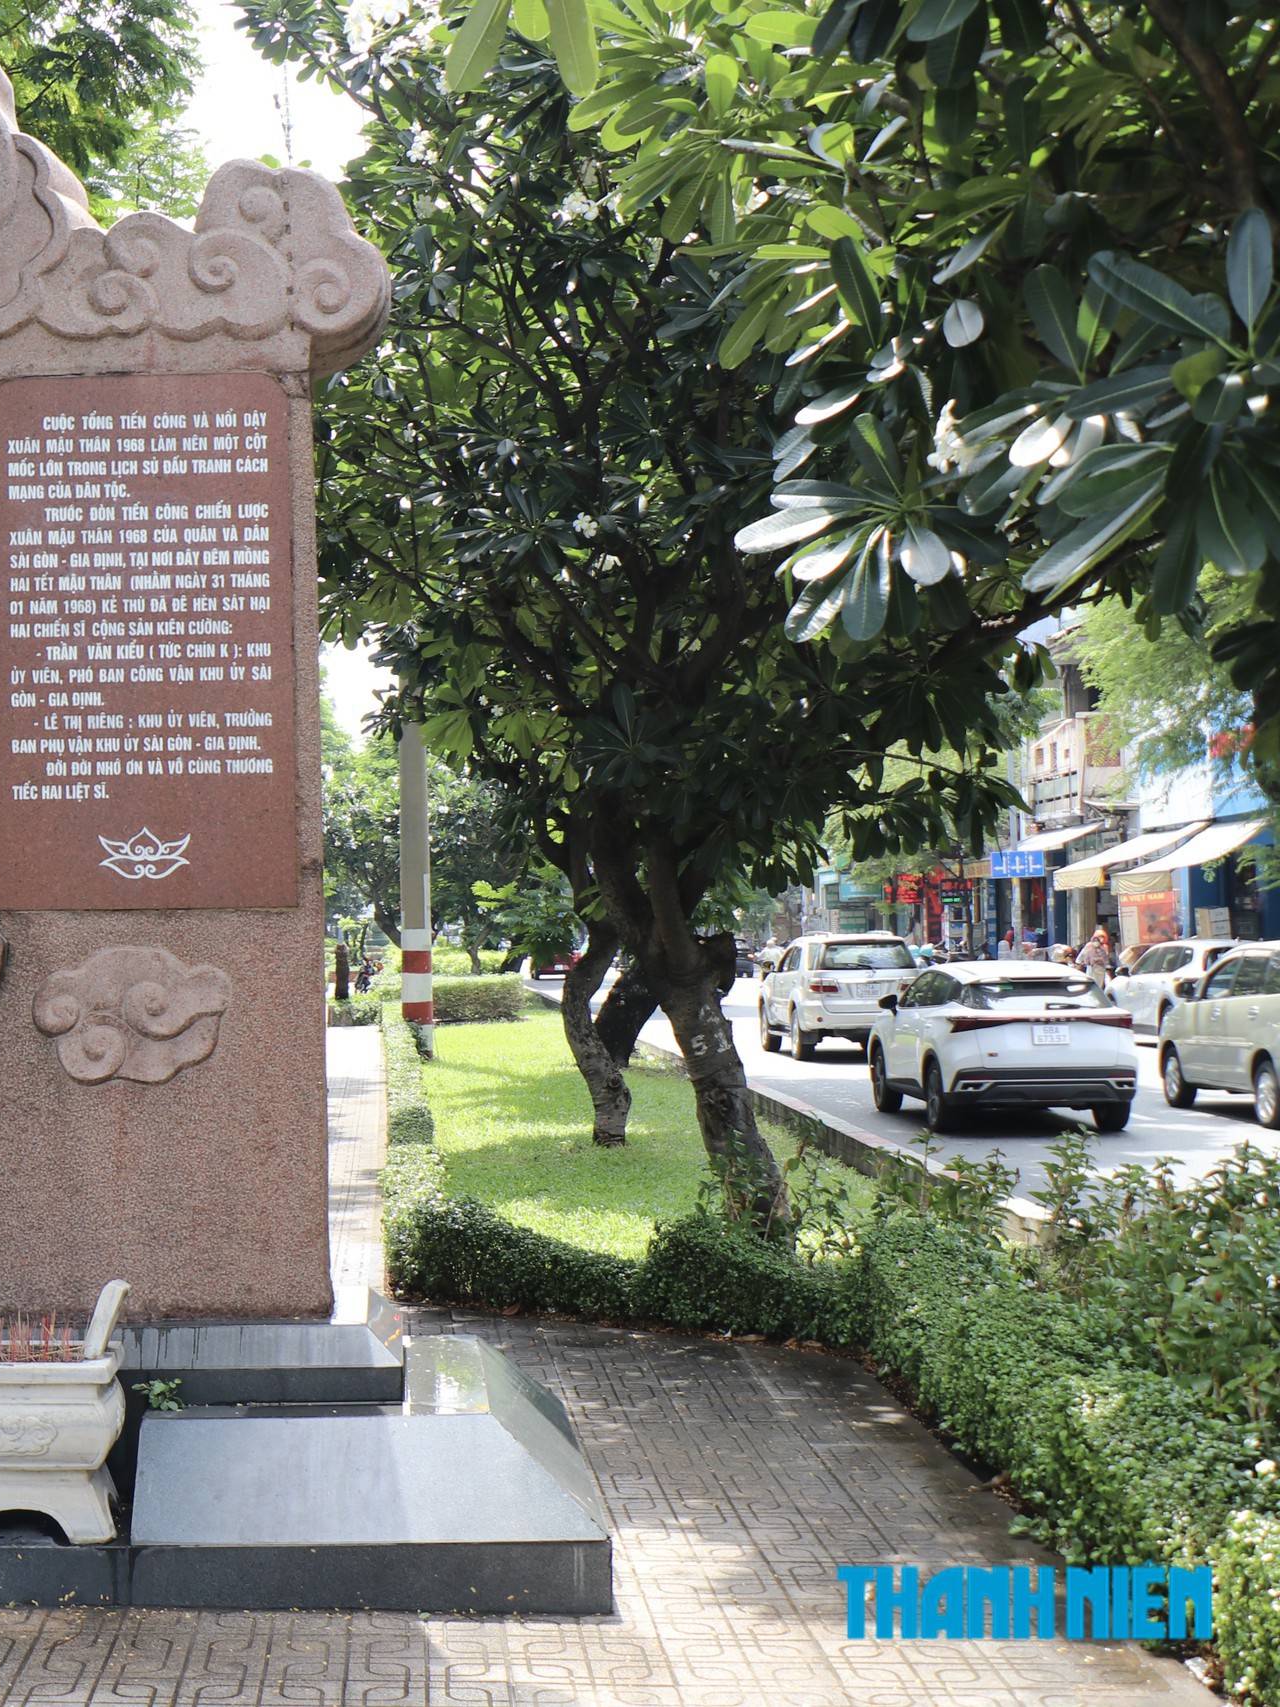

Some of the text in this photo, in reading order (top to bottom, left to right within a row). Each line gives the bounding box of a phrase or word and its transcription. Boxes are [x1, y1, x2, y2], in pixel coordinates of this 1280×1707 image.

[42, 407, 267, 434] CUỘC TỔNG TIẾN CÔNG VÀ NỔI DẬY
[7, 432, 268, 457] XUÂN MẬU THÂN 1968 LÀM NÊN MỘT CỘT
[7, 457, 35, 478] MỐC
[39, 458, 63, 477] LỚN
[66, 460, 107, 477] TRONG
[110, 460, 138, 479] LỊCH
[161, 454, 188, 476] ĐẤU
[190, 458, 232, 475] TRANH
[235, 454, 269, 473] CÁCH
[7, 480, 131, 503] MẠNG CỦA DÂN TỘC.
[44, 499, 269, 523] TRƯỚC ĐÒN TIẾN CÔNG CHIẾN LƯỢC
[8, 523, 270, 548] XUÂN MẬU THÂN 1968 CỦA QUÂN VÀ DÂN
[9, 545, 270, 571] SÀI GÒN GIA ĐỊNH, TẠI NƠI ĐÂY ĐÊM MỒNG
[9, 576, 30, 593] HAI
[33, 571, 54, 592] TẾT
[58, 572, 86, 595] MẬU
[89, 572, 122, 591] THÂN
[175, 571, 207, 589] NGÀY
[211, 574, 225, 589] 31
[229, 570, 271, 589] THÁNG
[9, 600, 24, 616] 01
[29, 597, 58, 615] NĂM
[63, 599, 97, 616] 1968)
[101, 594, 118, 614] KẺ
[149, 595, 167, 613] ĐÃ
[171, 594, 188, 612] ĐÊ
[192, 593, 218, 612] HÈN
[221, 593, 246, 612] SÁT
[249, 595, 271, 615] HẠI
[9, 623, 31, 639] HAI
[33, 617, 70, 638] CHIẾN
[72, 619, 86, 637] SĨ
[91, 617, 125, 640] CỘNG
[128, 617, 154, 637] SẢN
[156, 617, 185, 636] KIÊN
[45, 640, 78, 661] TRẦN
[86, 642, 112, 661] VĂN
[116, 638, 144, 660] KIỂU
[158, 640, 182, 659] TỨC
[219, 643, 229, 658] K
[246, 641, 272, 658] KHU
[9, 661, 272, 686] ỦY VIÊN, PHÓ BAN CÔNG VẬN KHU ỦY SÀI
[10, 689, 105, 710] GÒN GIA ĐỊNH.
[43, 712, 59, 731] LÊ
[62, 715, 82, 733] THỊ
[86, 710, 124, 730] RIÊNG
[137, 713, 163, 729] KHU
[166, 708, 183, 729] ỦY
[187, 710, 220, 730] VIÊN,
[11, 732, 262, 757] BAN PHỤ VẬN KHU ỦY SÀI GÒN GIA ĐỊNH.
[45, 756, 274, 777] ĐỜI ĐỜI NHỚ ƠN VÀ VÔ CÙNG THƯƠNG
[11, 780, 110, 803] TIẾC HAI LIỆT SĨ.
